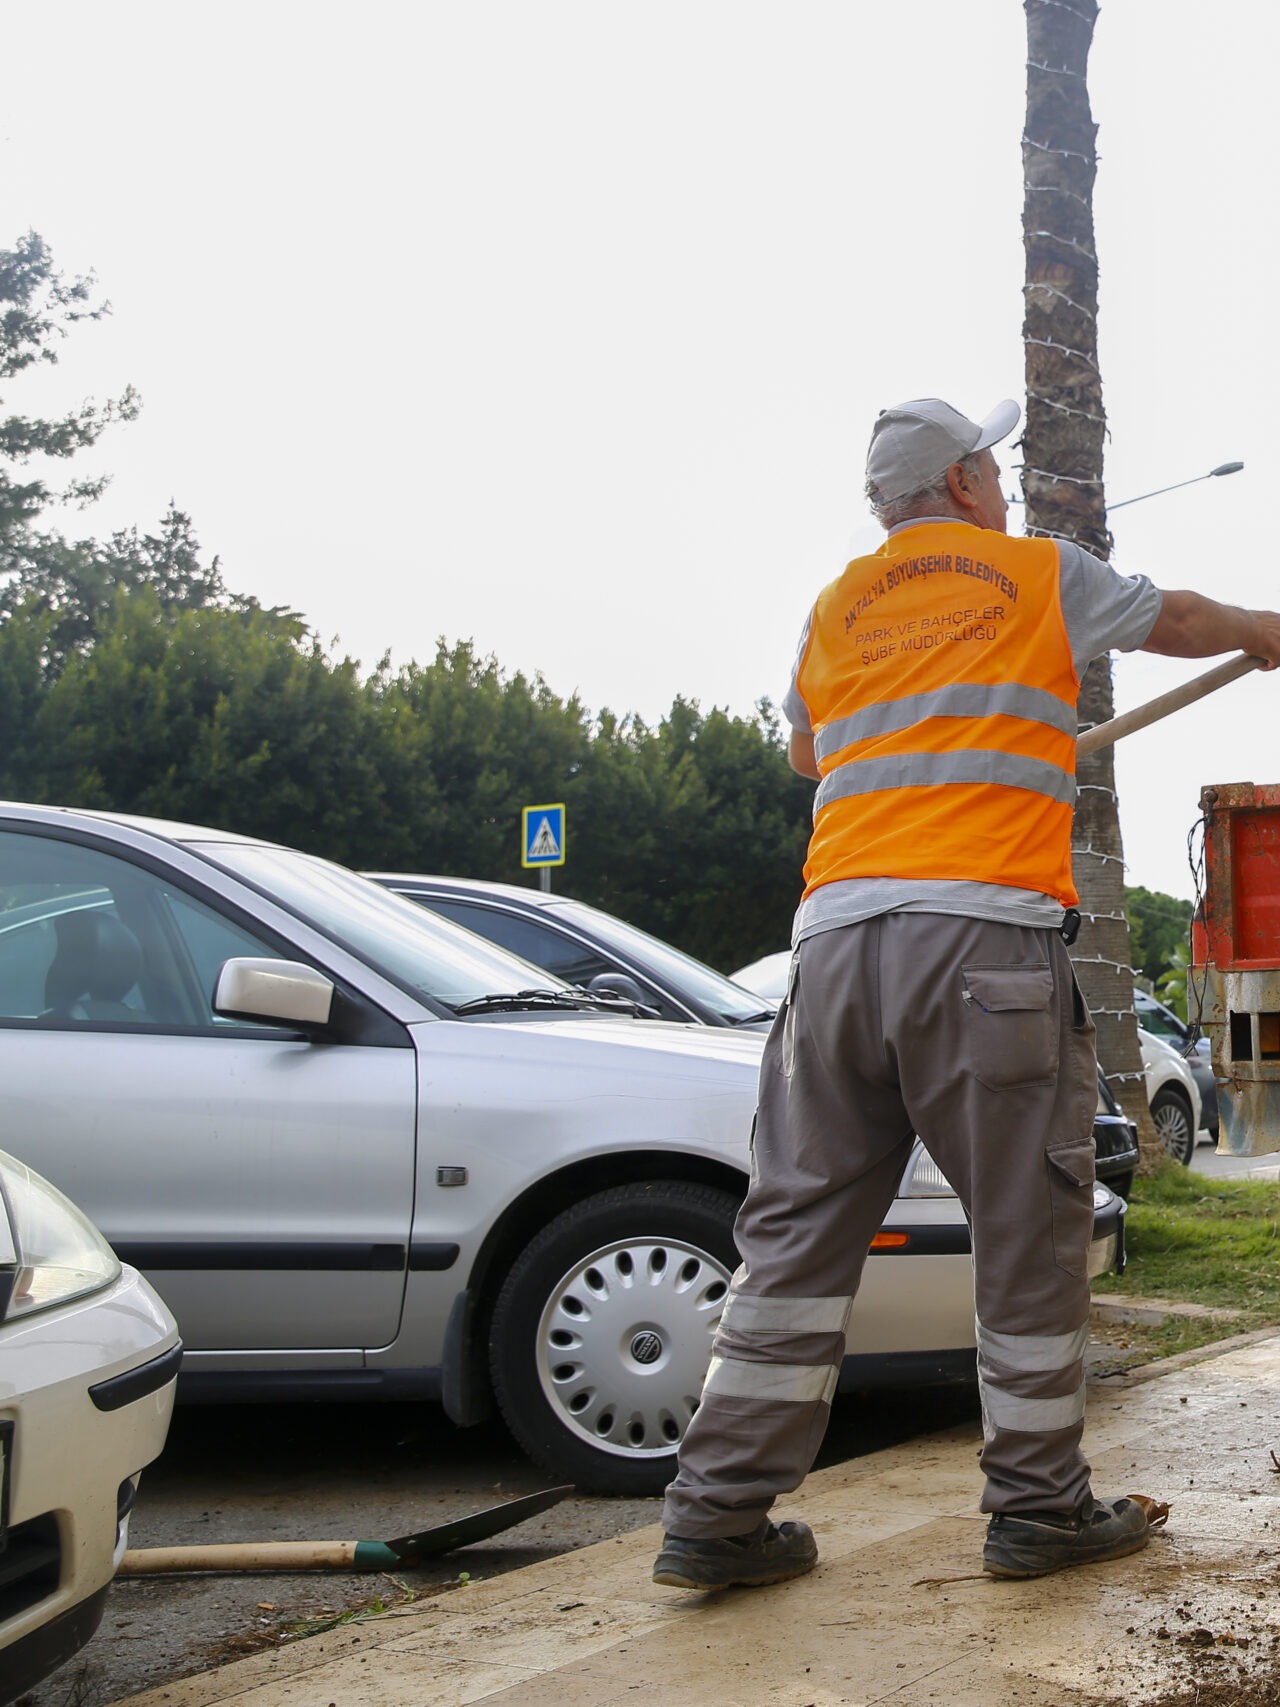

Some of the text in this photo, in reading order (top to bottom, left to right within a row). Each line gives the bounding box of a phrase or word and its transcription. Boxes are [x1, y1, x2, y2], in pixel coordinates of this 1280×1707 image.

[844, 551, 1019, 634] ANTALYA BÜYÜKŞEHİR BELEDİYESİ
[855, 606, 1005, 647] PARK VE BAHÇELER
[861, 624, 997, 666] ŞUBE MÜDÜRLÜĞÜ
